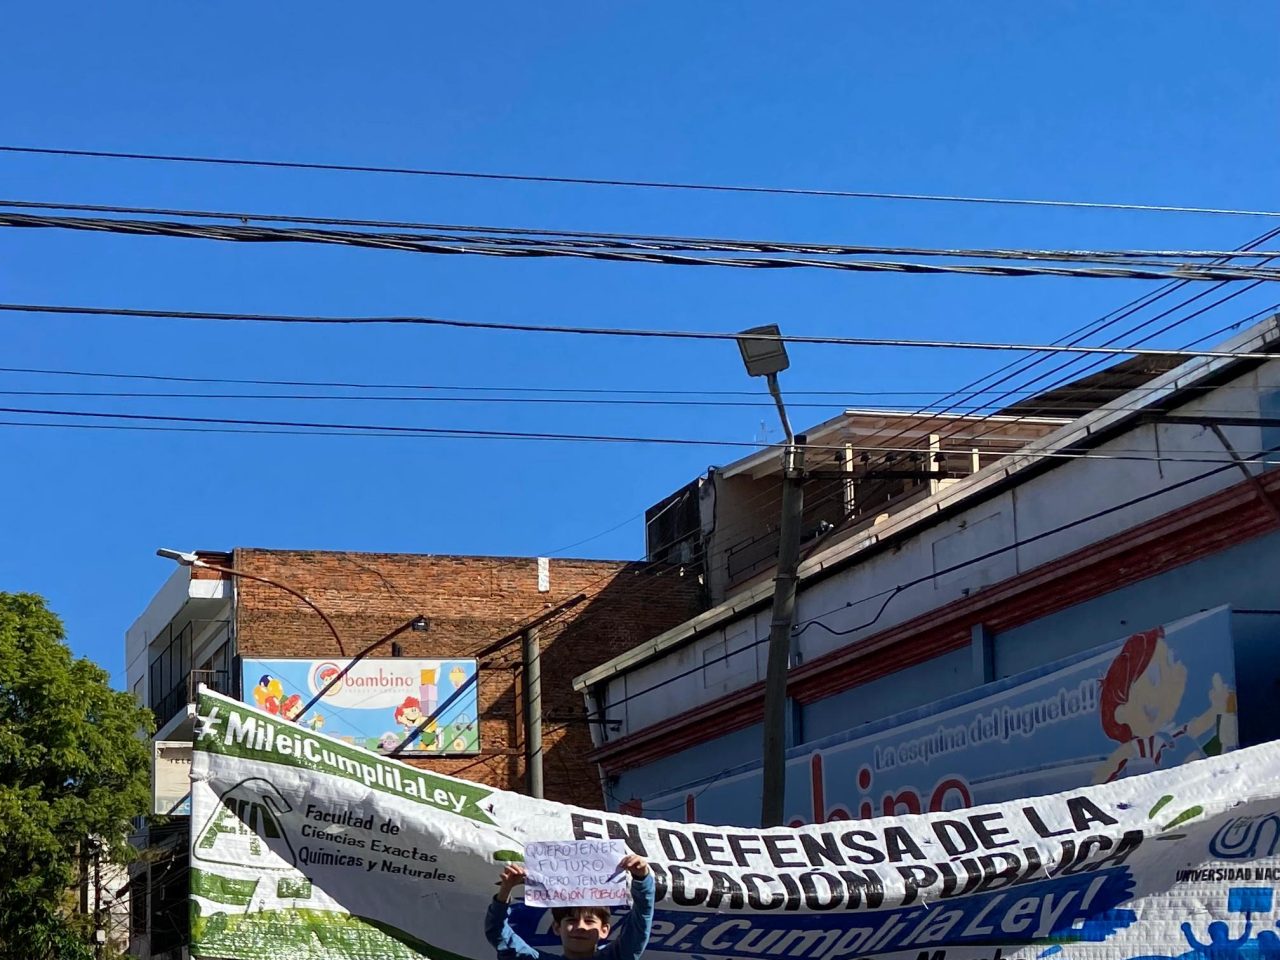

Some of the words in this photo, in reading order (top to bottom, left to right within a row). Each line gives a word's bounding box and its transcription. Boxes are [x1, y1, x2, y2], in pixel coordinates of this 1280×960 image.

[345, 668, 414, 687] bambino
[875, 746, 897, 770] La
[970, 709, 1001, 745] del
[305, 804, 373, 830] Facultad
[380, 818, 401, 836] de
[570, 812, 648, 857] EN
[657, 826, 927, 868] DEFENSA
[931, 812, 1020, 857] DE
[1022, 796, 1119, 839] LA
[301, 824, 366, 851] Ciencias
[371, 840, 438, 862] Exactas
[526, 843, 571, 858] QUIERO
[571, 841, 620, 856] TENER
[299, 846, 364, 867] Químicas
[366, 860, 377, 872] y
[380, 860, 456, 883] Naturales
[538, 858, 605, 872] FUTURO
[897, 830, 1144, 906] PÚBLICA
[1176, 867, 1252, 882] UNIVERSIDAD
[898, 905, 965, 946] la
[960, 875, 1110, 939] Ley!
